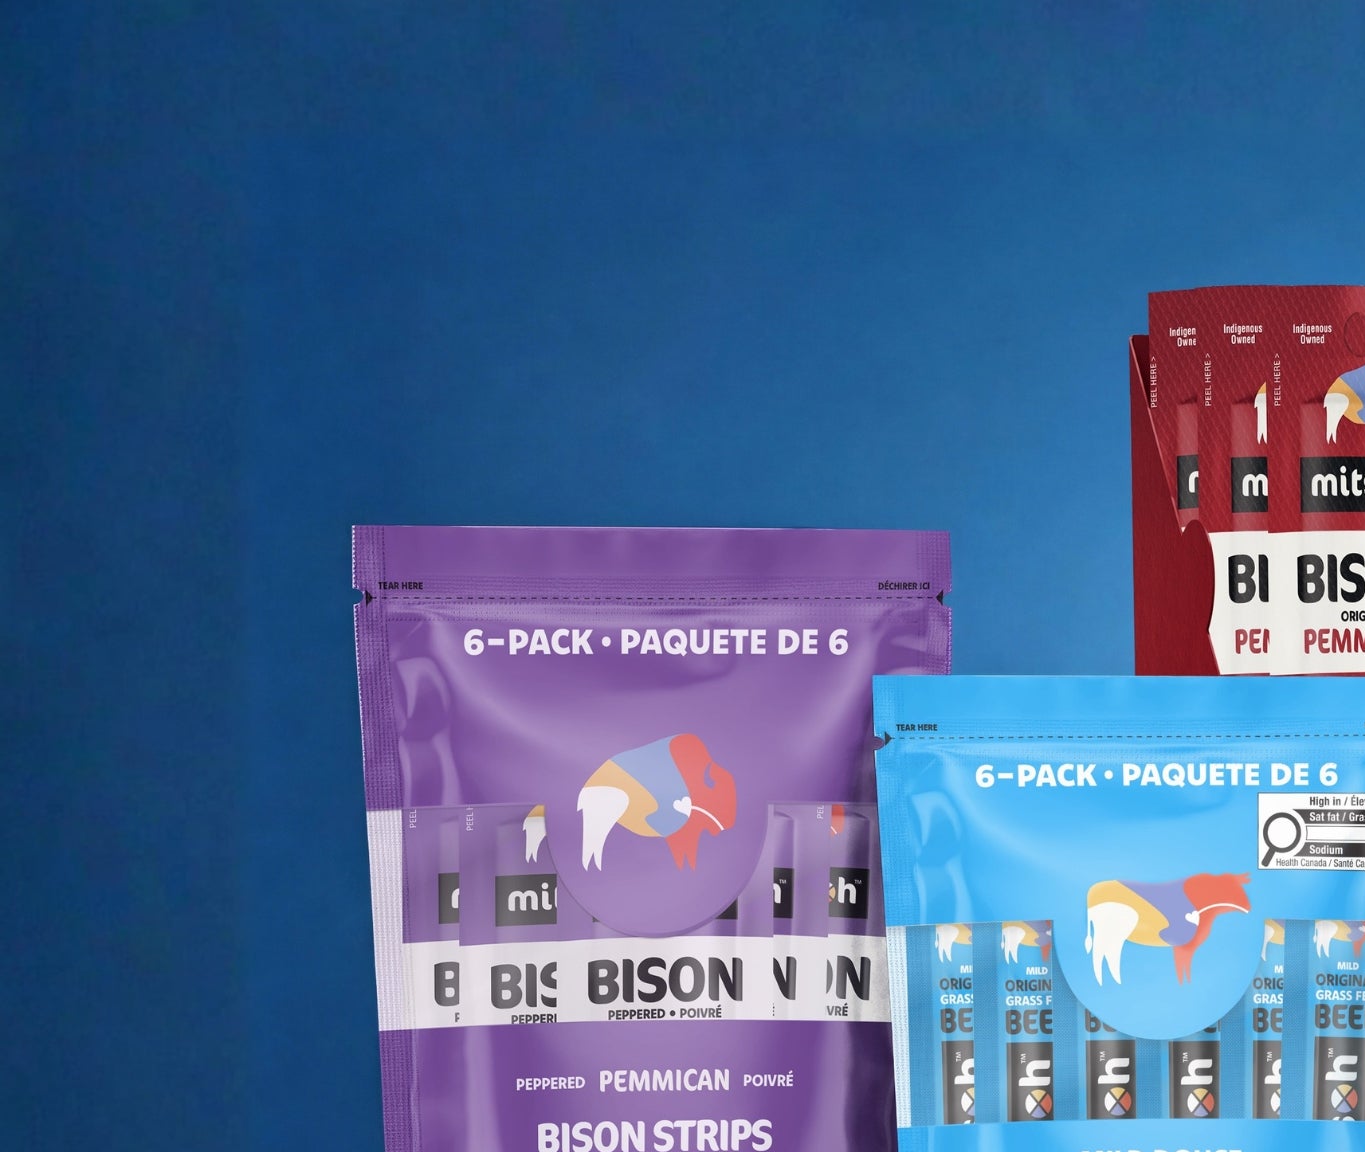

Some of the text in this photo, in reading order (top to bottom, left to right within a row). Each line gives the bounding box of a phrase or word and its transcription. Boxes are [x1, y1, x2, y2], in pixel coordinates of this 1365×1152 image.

[378, 581, 423, 589] TEAR HERE
[463, 627, 848, 655] 6-PACK PAQUETE DE 6
[975, 761, 1338, 788] 6-PACK PAQUETE DE 6
[1309, 795, 1329, 807] High
[1332, 795, 1341, 806] in
[1309, 811, 1323, 822] Sat
[1326, 811, 1339, 822] fat
[1309, 844, 1343, 854] Sodium
[1276, 857, 1298, 867] Health
[1300, 857, 1327, 867] Canada
[1334, 857, 1353, 867] Santé
[1337, 960, 1359, 971] MILD
[587, 956, 743, 1003] BISON
[1316, 988, 1352, 1000] GRASS
[608, 1003, 722, 1020] PEPPERED POIVRÉ
[517, 1068, 793, 1092] PEPPERED PEMMICAN POIVRÉ
[653, 1119, 773, 1151] STRIPS
